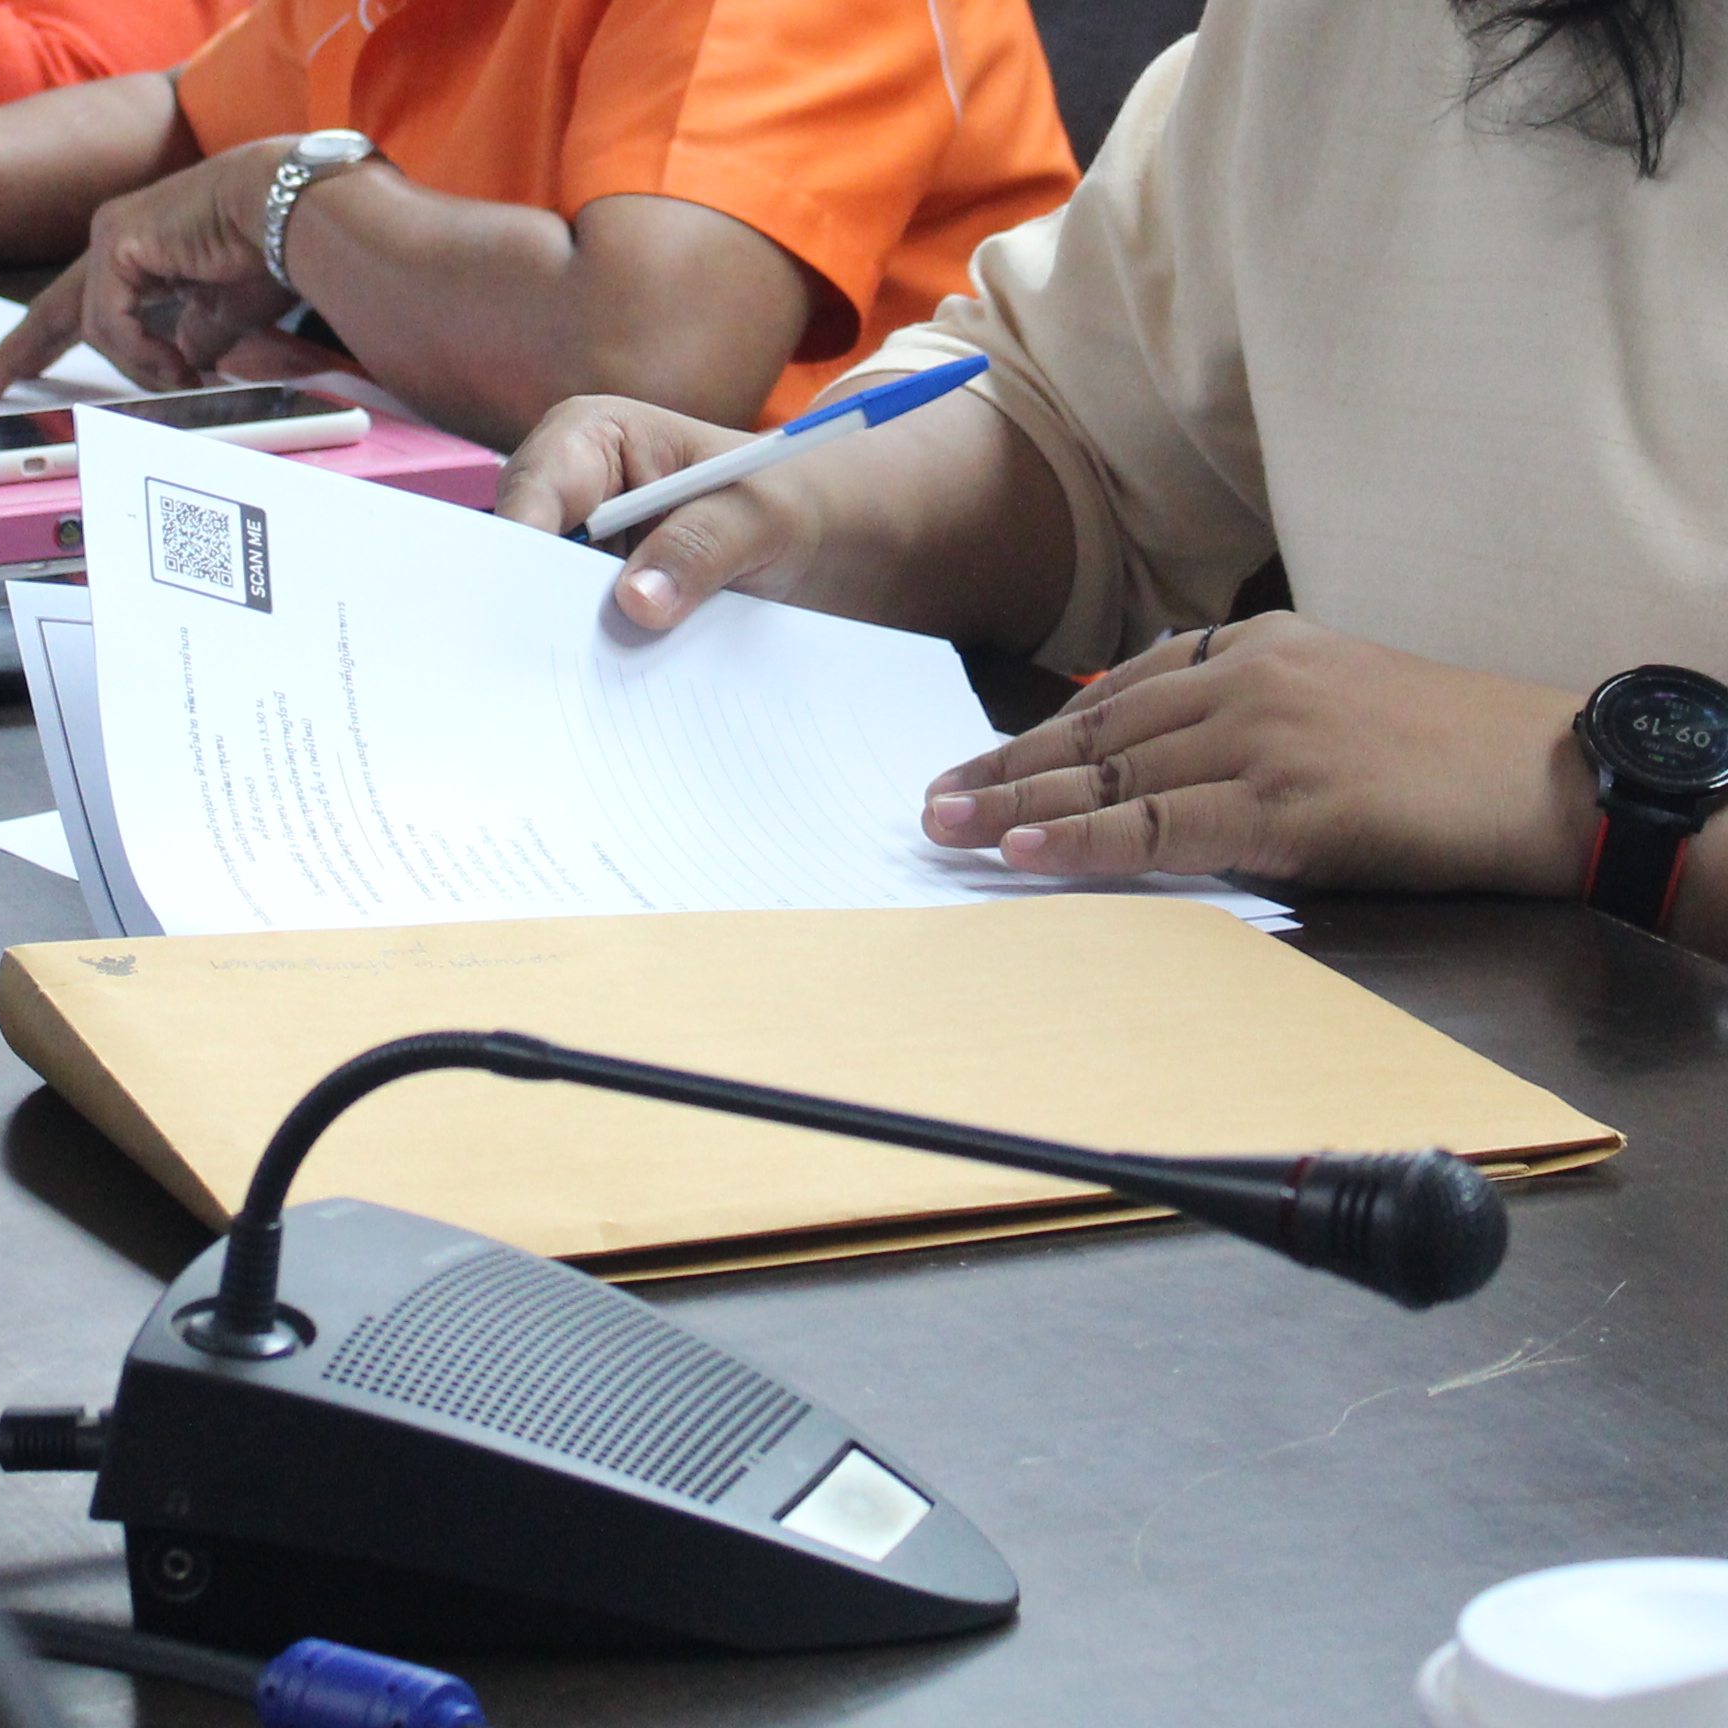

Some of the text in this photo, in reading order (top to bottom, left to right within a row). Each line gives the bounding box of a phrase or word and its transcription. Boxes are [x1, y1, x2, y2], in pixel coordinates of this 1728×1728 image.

[246, 518, 267, 599] SCAN ME
[177, 626, 197, 715] พัฒนาการอำเภอ
[255, 698, 265, 709] น.
[255, 711, 271, 743] 13.30
[1632, 715, 1711, 750] 09:19
[188, 718, 207, 777] หัวหน้าฝ่าย
[262, 747, 275, 772] เวลา
[215, 734, 257, 863] และนักวิชาการพัฒนาชุมชน
[243, 776, 263, 814] 8/2563
[267, 774, 283, 802] 2563
[309, 781, 327, 796] ชั้น
[276, 803, 296, 841] กันยายน
